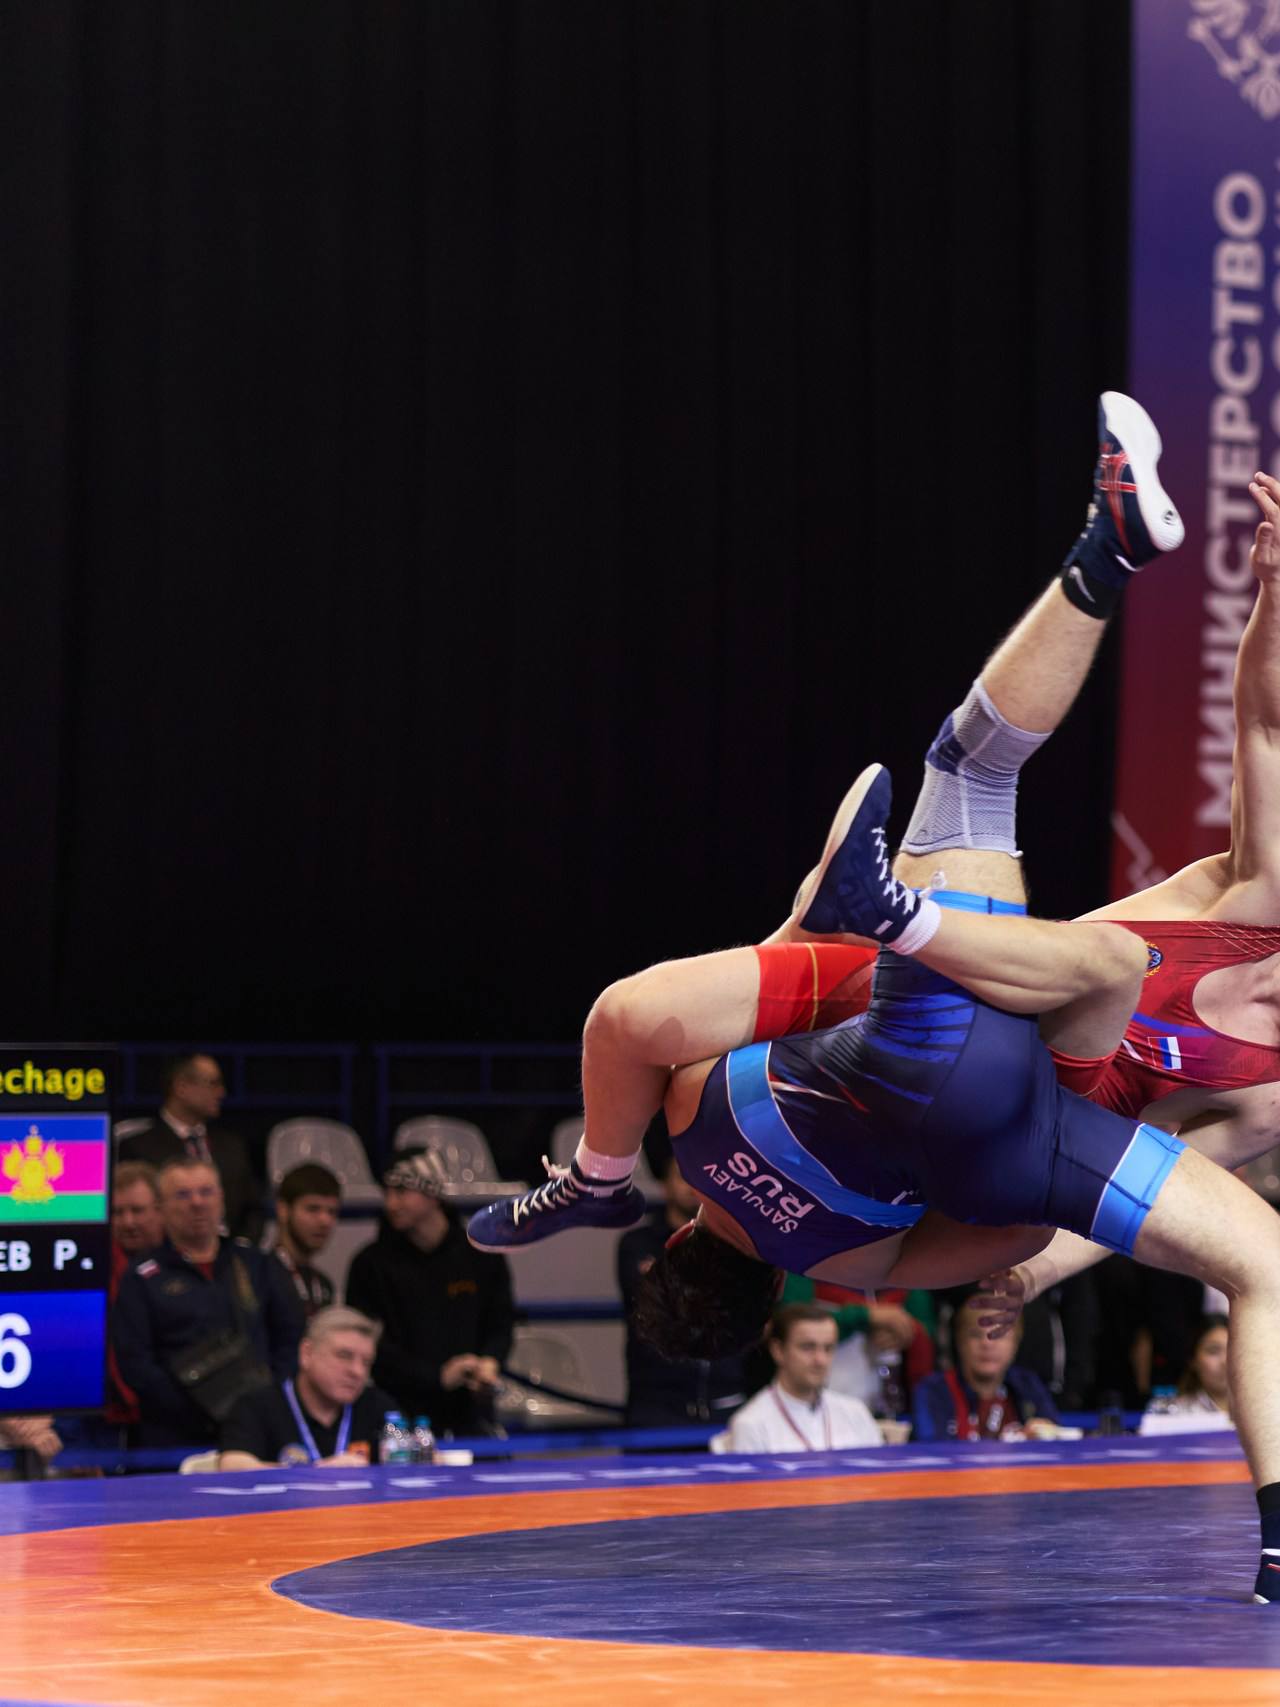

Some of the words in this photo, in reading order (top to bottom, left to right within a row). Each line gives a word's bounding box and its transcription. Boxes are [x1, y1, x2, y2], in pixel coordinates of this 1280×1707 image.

[1196, 172, 1266, 828] МИНИСТЕРСТВО
[0, 1060, 105, 1101] chage
[703, 1163, 799, 1233] SADULAEV
[727, 1151, 816, 1219] RUS
[0, 1312, 32, 1389] 6
